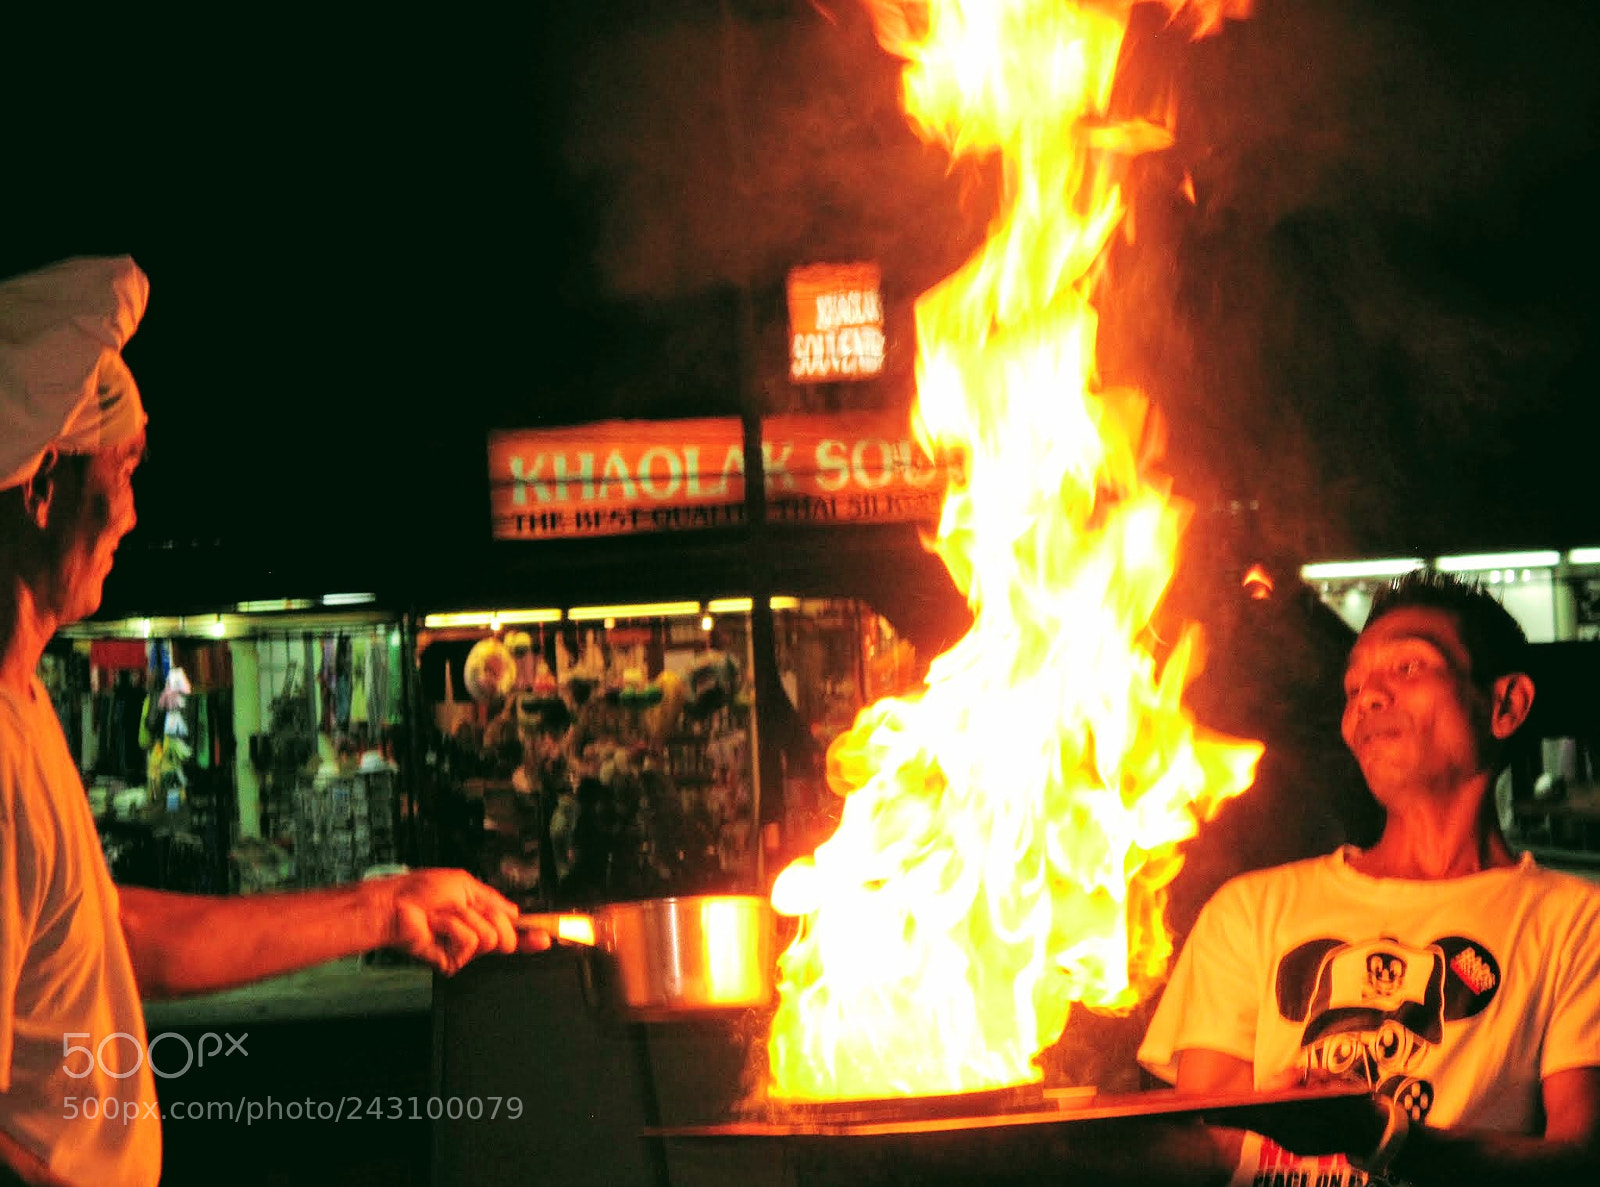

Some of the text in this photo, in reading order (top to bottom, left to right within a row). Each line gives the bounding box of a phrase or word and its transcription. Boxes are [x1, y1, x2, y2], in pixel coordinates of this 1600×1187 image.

[509, 440, 794, 506] KHAOLAK
[513, 511, 563, 533] THE
[575, 507, 640, 531] BEST
[650, 503, 748, 529] QUALIT
